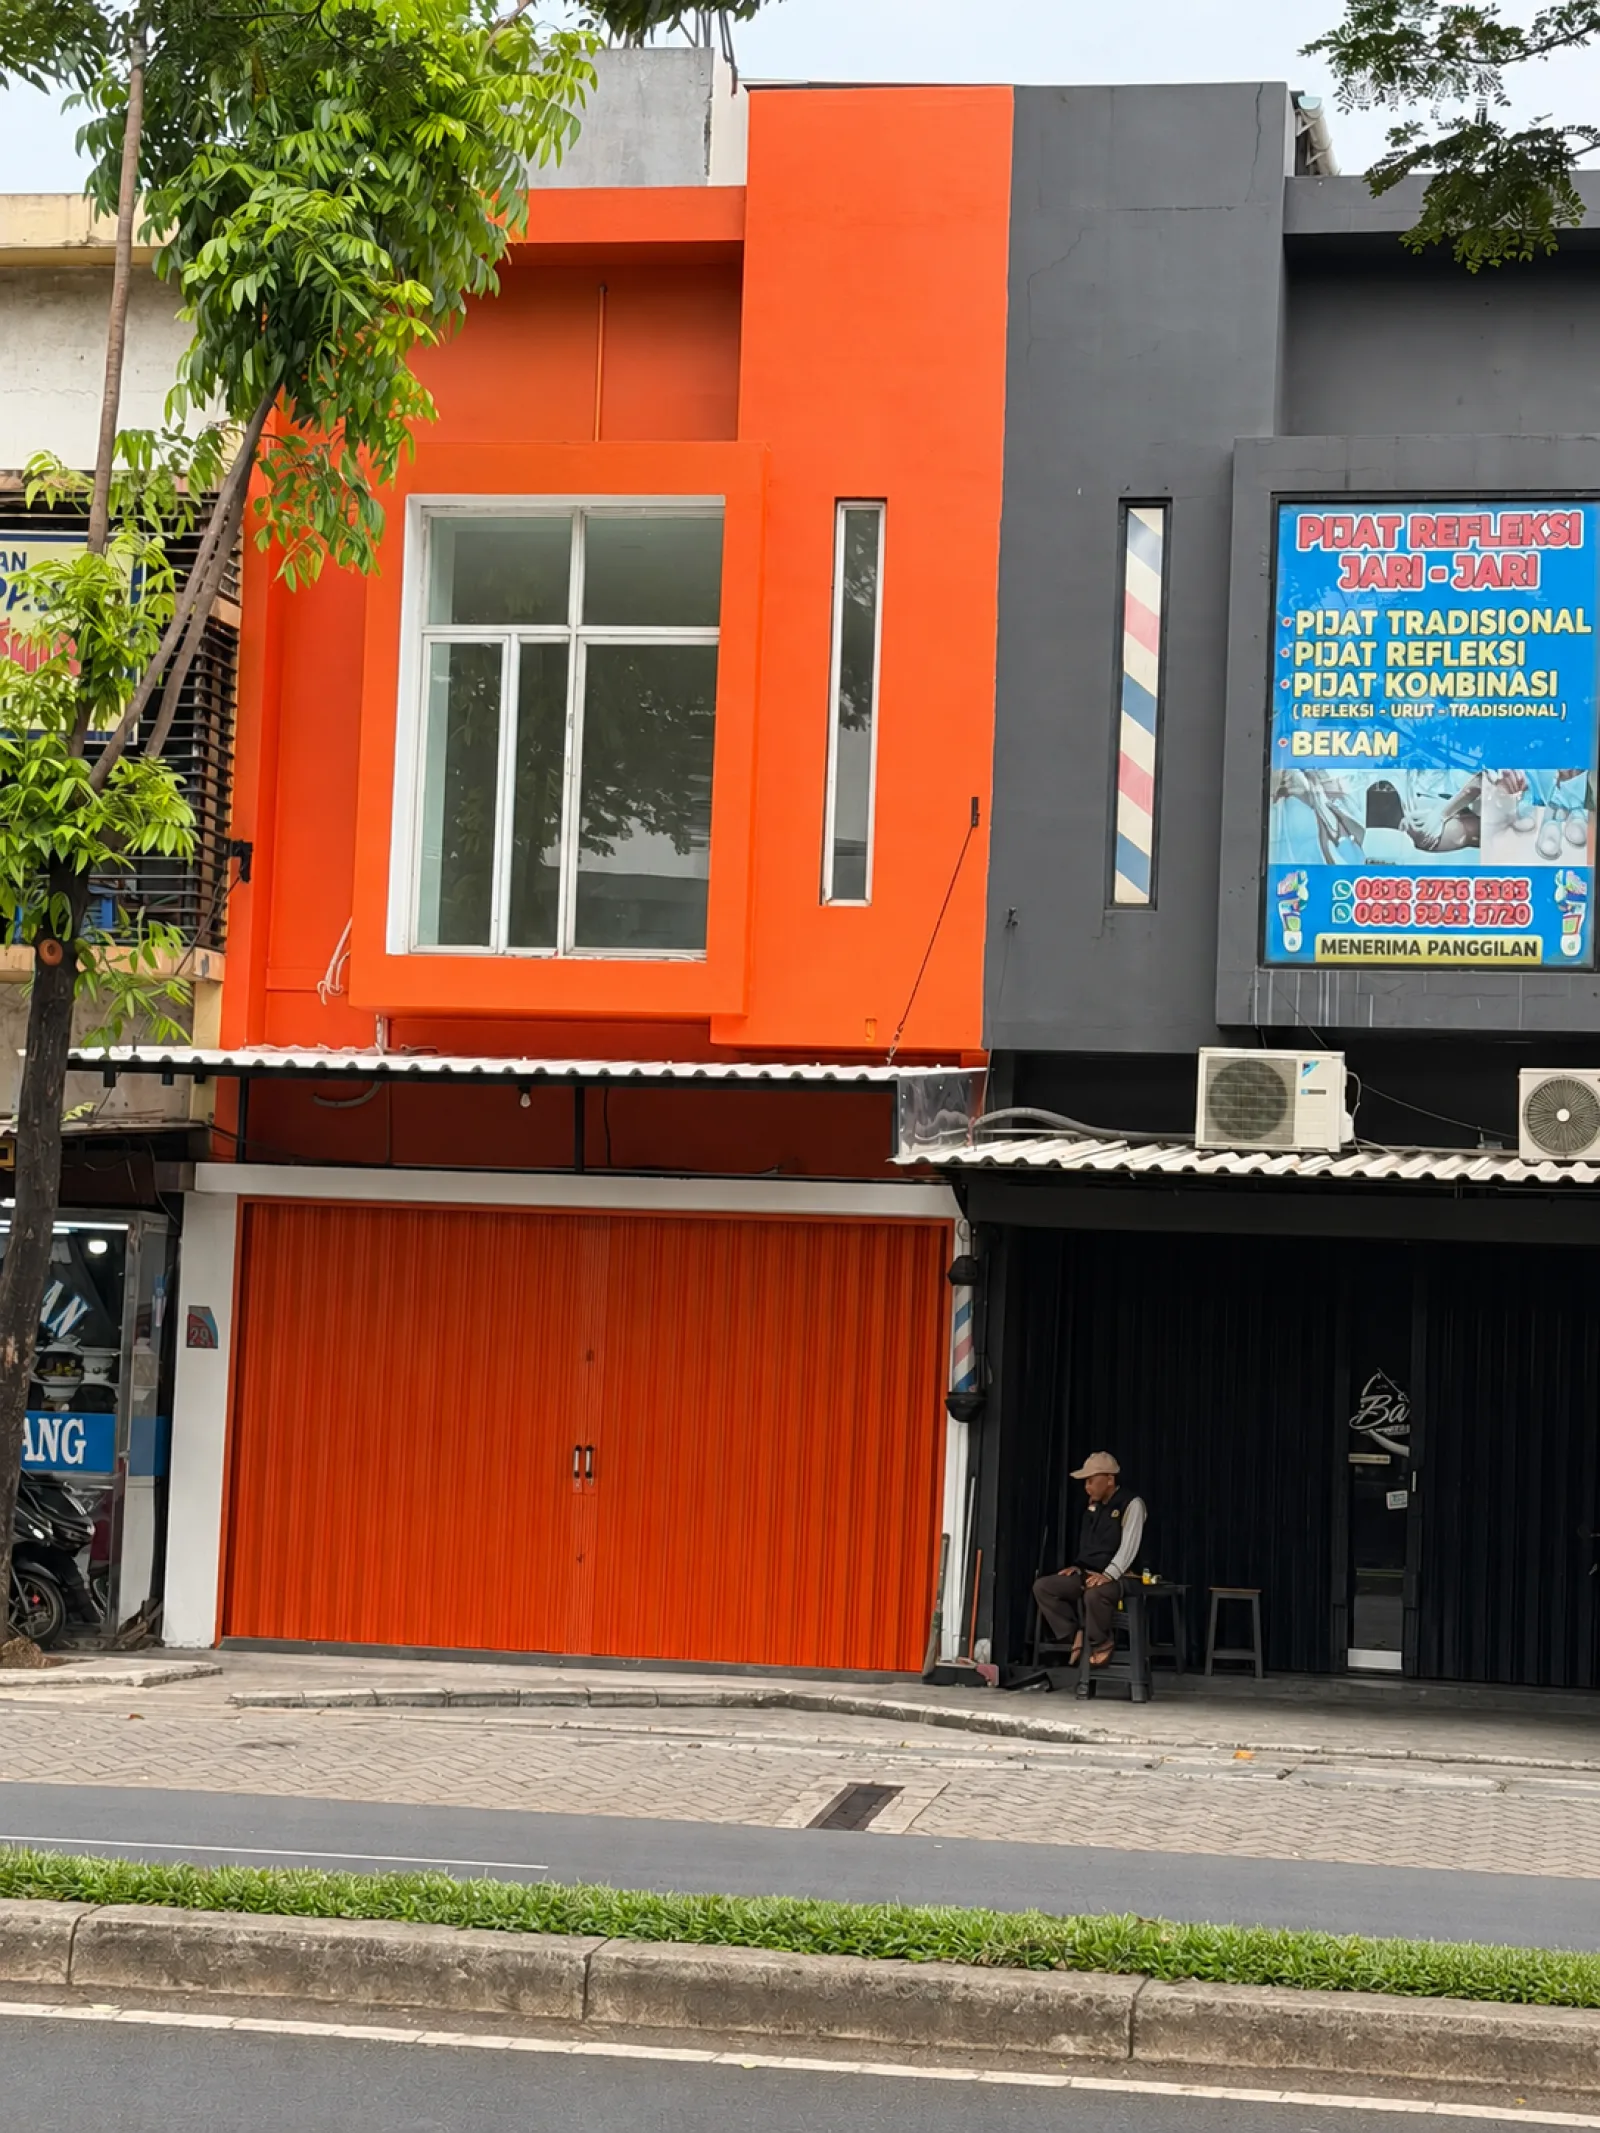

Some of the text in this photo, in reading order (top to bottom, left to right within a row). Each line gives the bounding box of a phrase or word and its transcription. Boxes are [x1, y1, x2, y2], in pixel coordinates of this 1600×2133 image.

[1298, 512, 1582, 549] PIJAT REFLEKSI
[1339, 555, 1424, 589] JARI
[1453, 553, 1539, 588] JARI
[1295, 608, 1592, 636] PIJAT TRADISIONAL
[1294, 640, 1526, 667] PIJAT REFLEKSI
[1293, 670, 1558, 698] PIJAT KOMBINASI
[1390, 704, 1434, 718] URUT
[1291, 731, 1399, 757] BEKAM
[1474, 902, 1531, 925] 5720
[1321, 939, 1538, 958] MENERIMA PANGGILAN
